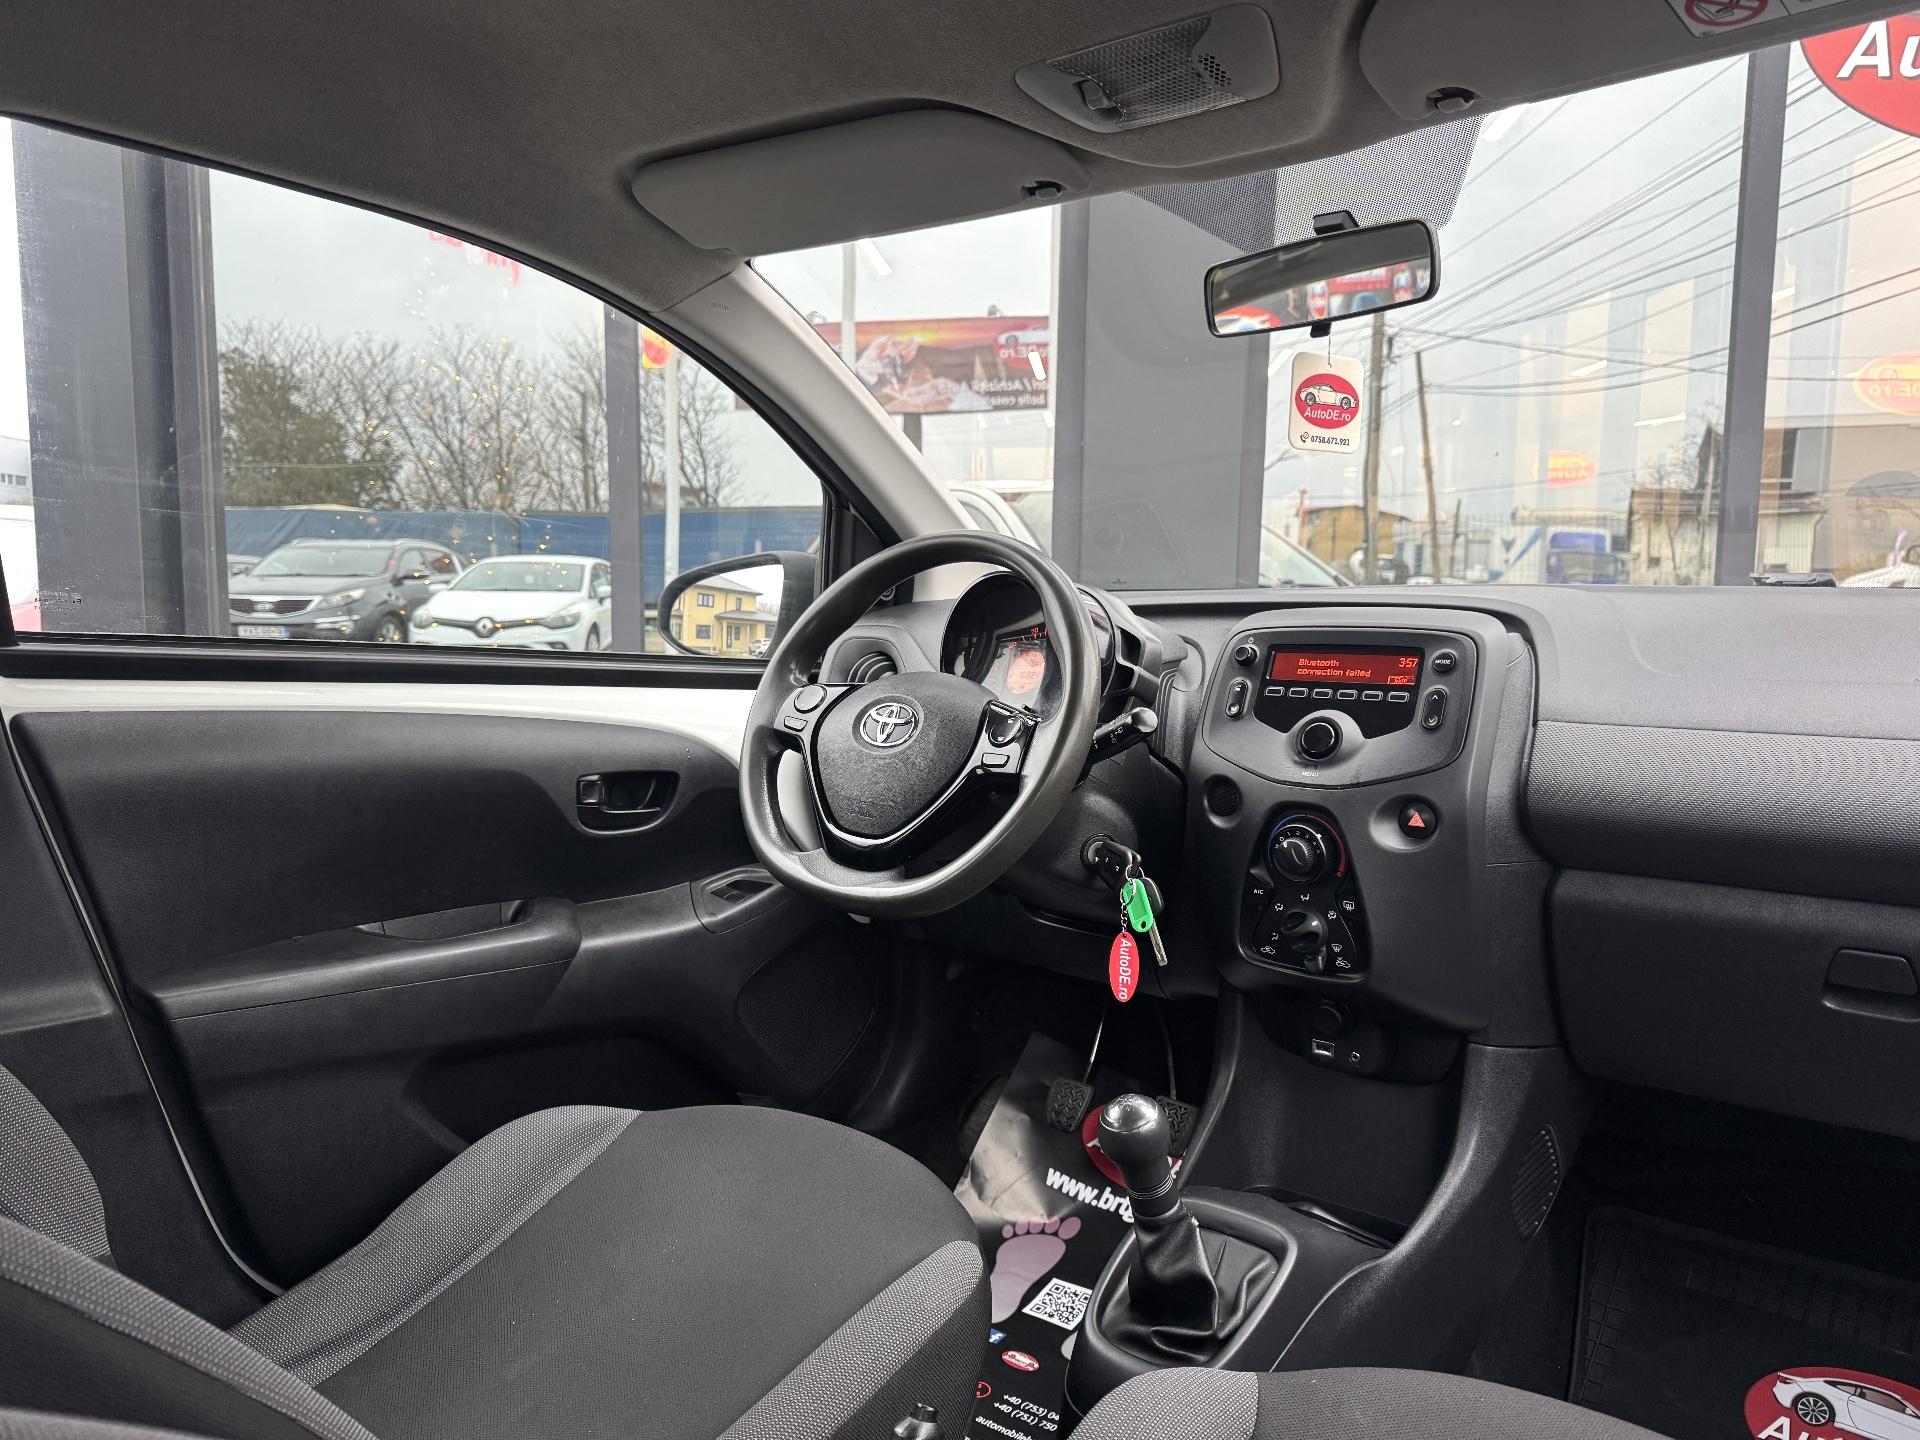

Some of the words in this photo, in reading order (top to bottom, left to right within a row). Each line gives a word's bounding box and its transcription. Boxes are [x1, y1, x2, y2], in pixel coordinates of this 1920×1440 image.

[1303, 407, 1351, 422] AutoDE.ro
[1298, 658, 1339, 667] Bluetooth
[1297, 668, 1343, 677] connection
[1345, 669, 1371, 678] failed
[1119, 938, 1132, 1000] AutoDE.ro
[1003, 1394, 1021, 1406] +40
[993, 1402, 1012, 1413] +40
